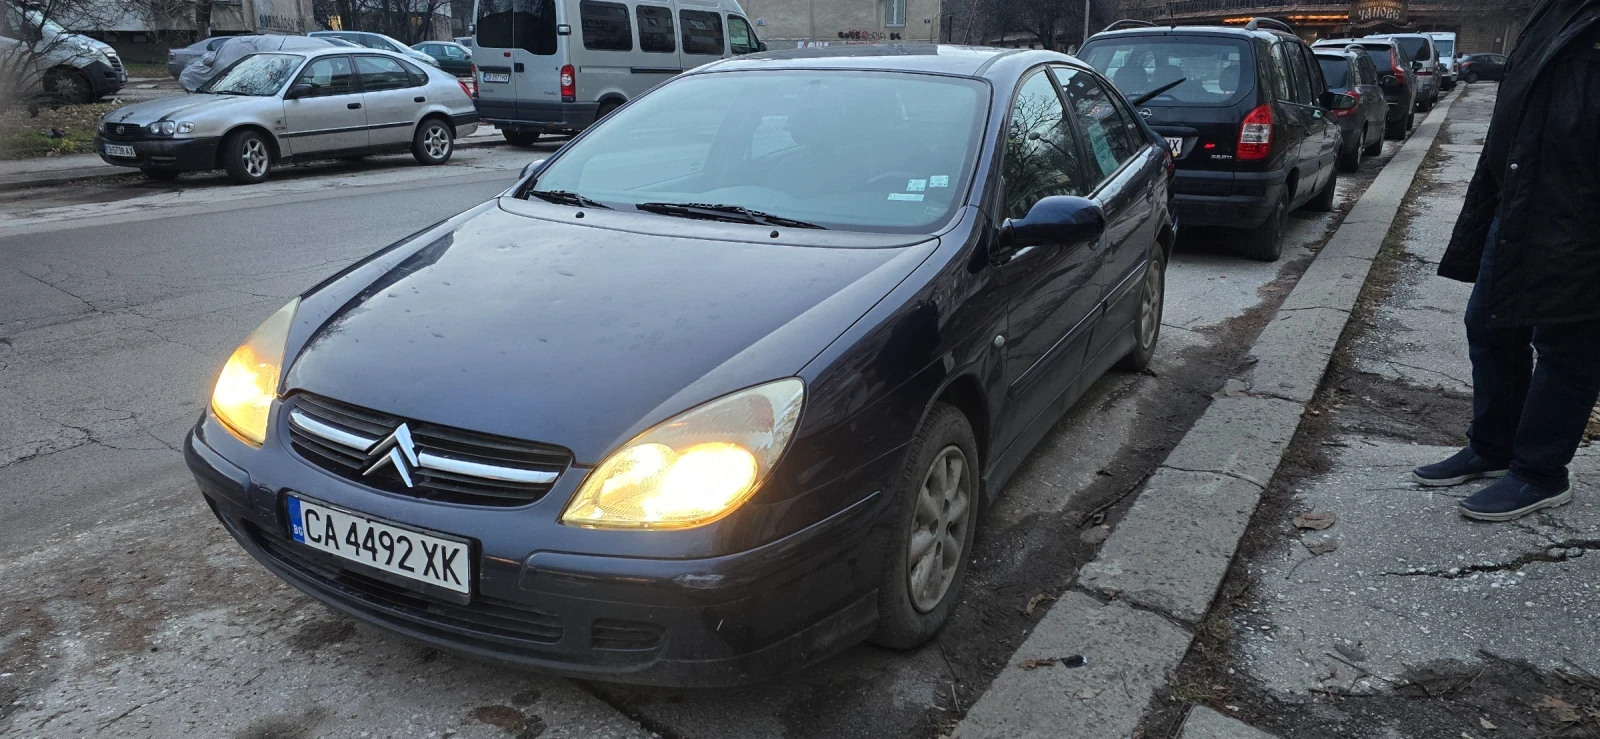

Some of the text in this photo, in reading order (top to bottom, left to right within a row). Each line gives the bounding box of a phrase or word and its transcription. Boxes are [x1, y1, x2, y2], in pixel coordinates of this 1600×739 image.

[293, 523, 303, 537] BG
[305, 508, 462, 586] CA 4492 XK
